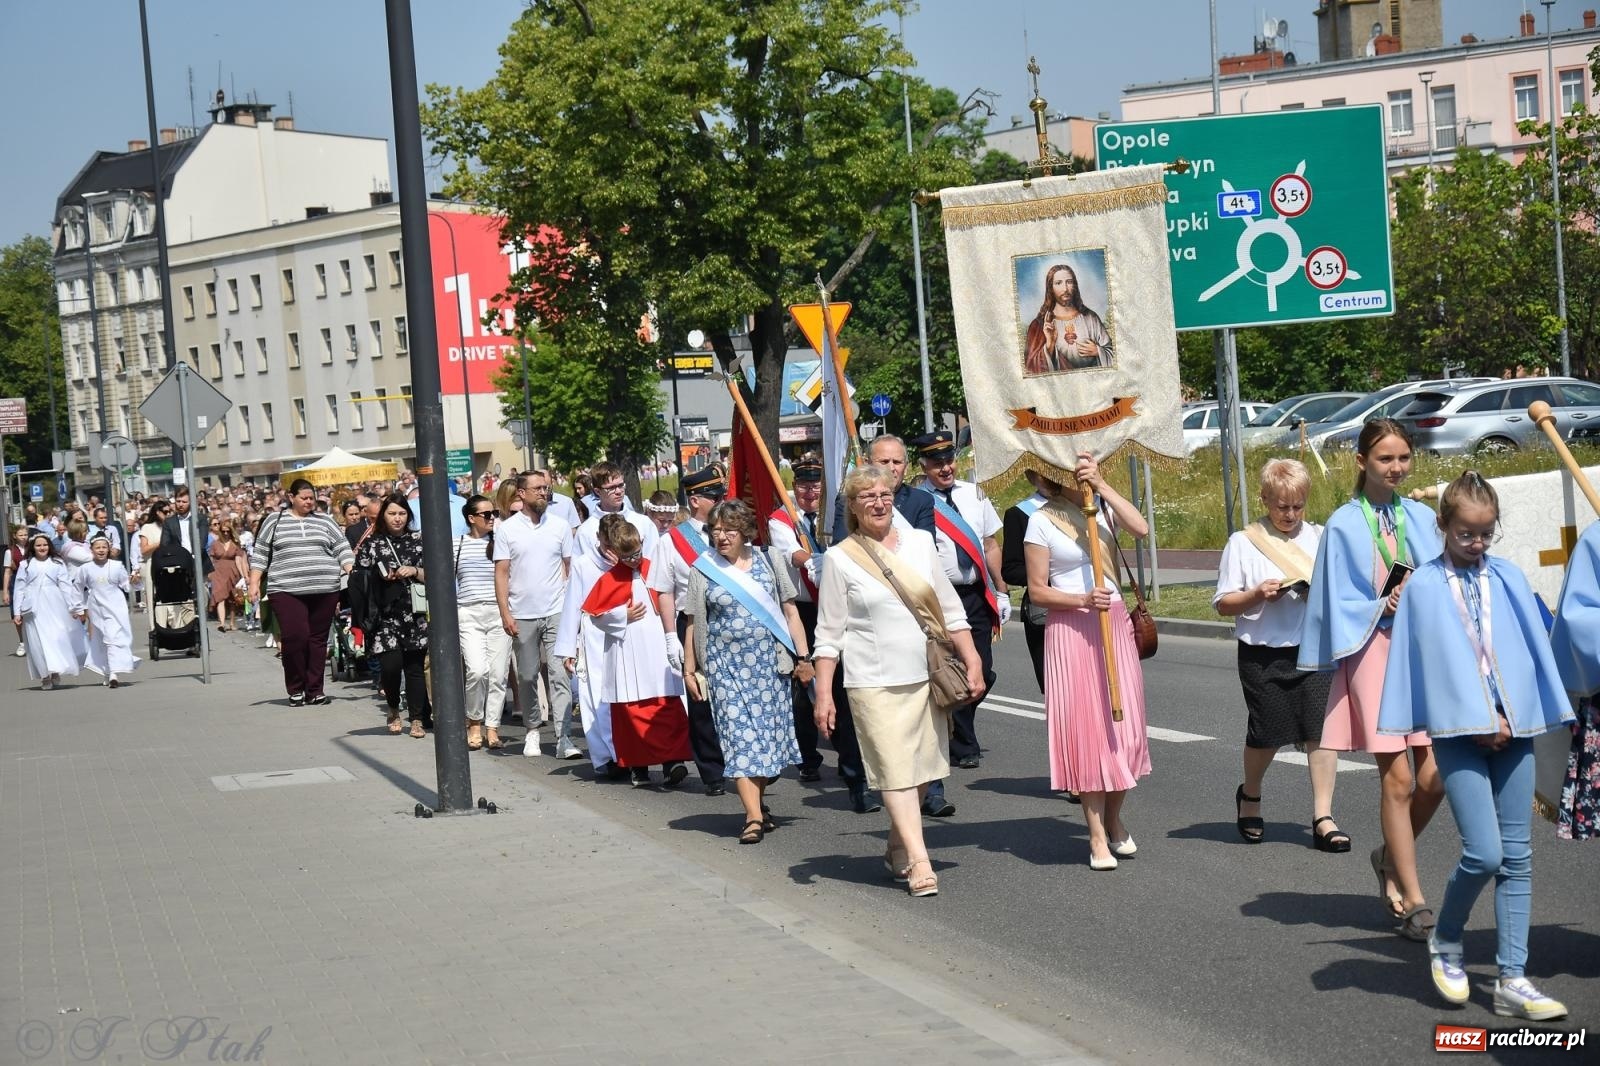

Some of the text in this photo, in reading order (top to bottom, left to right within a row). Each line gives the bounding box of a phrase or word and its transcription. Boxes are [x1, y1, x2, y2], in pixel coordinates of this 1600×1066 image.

[1102, 128, 1170, 155] Opole
[1230, 196, 1244, 209] 4t
[1277, 187, 1305, 203] 3,5t
[1312, 260, 1340, 276] 3,5t
[1324, 294, 1383, 310] Centrum
[448, 345, 496, 362] DRIVE
[1079, 416, 1098, 427] NAD
[1099, 406, 1121, 423] NAMI
